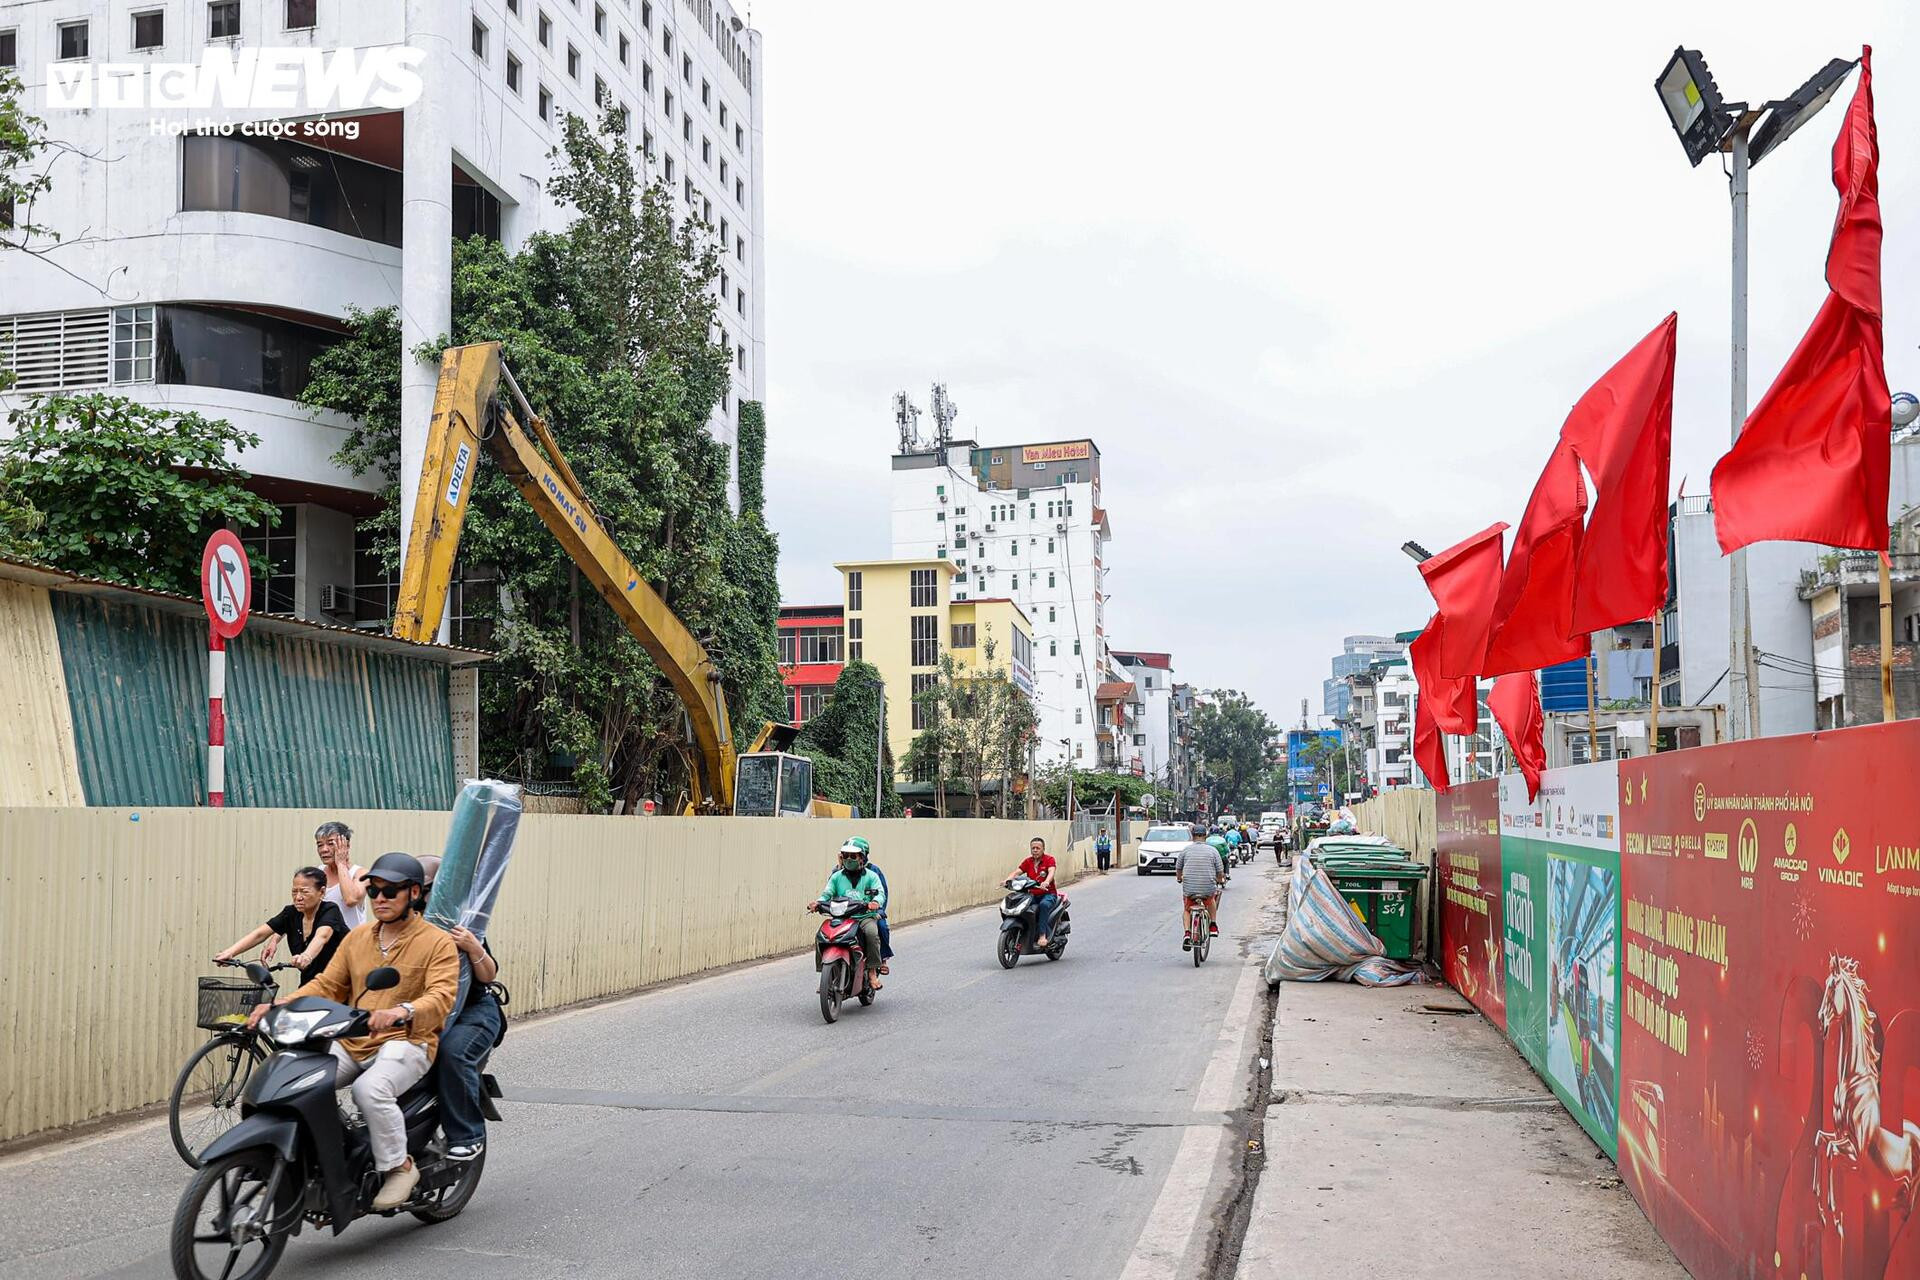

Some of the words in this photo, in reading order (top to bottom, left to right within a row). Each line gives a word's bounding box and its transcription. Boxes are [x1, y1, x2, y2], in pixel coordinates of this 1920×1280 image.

[450, 447, 469, 491] DELTA
[1754, 792, 1774, 812] THÀNH
[1775, 789, 1789, 812] PHỐ
[1790, 792, 1800, 812] HÀ
[1800, 792, 1814, 816] NỘI
[1818, 867, 1864, 888] VINADIC
[1398, 903, 1406, 917] 1
[1666, 905, 1693, 954] MỪNG
[1695, 914, 1729, 972] XUÂN,
[1669, 1009, 1688, 1057] MỚI
